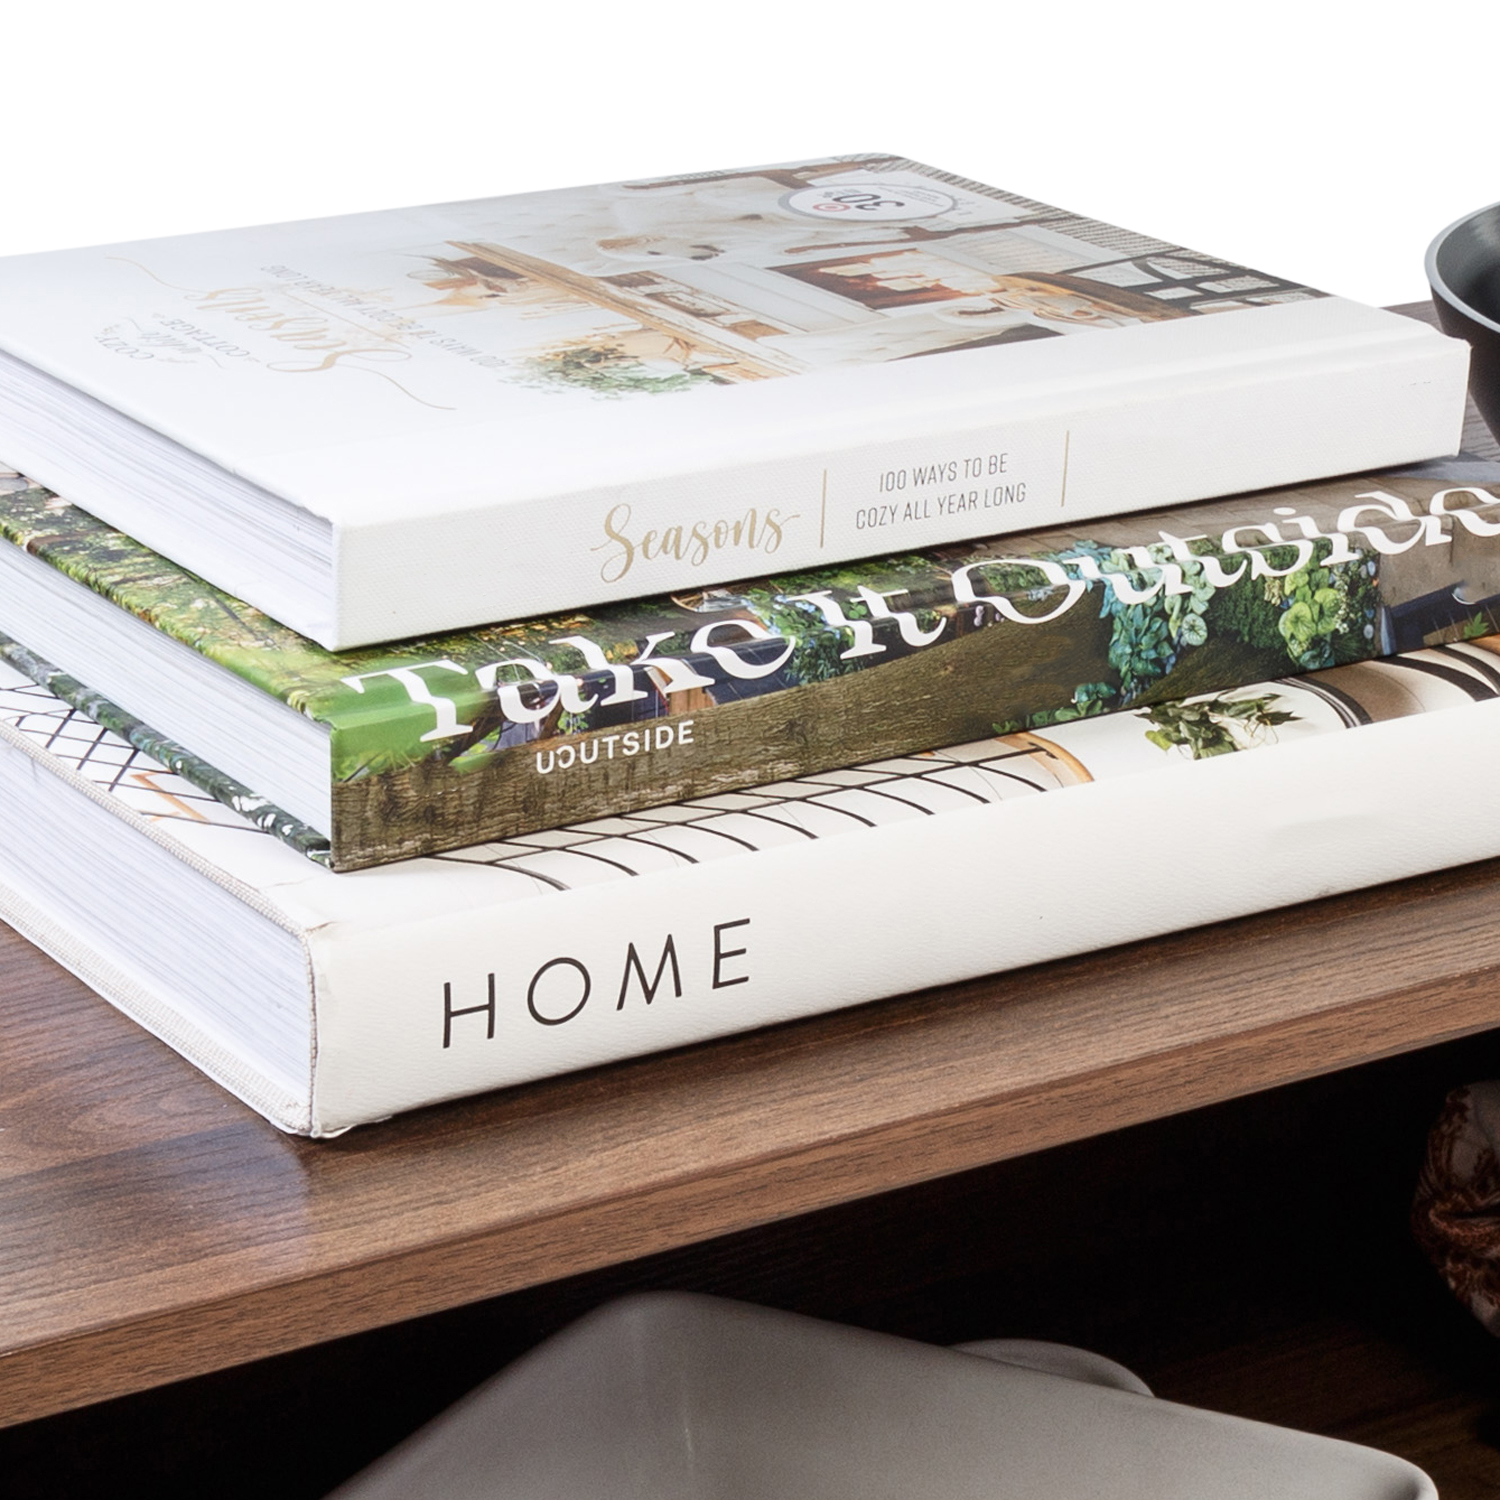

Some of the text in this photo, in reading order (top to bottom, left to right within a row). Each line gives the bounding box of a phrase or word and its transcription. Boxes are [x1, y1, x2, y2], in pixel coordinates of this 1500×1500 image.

[94, 336, 155, 360] COZY
[160, 318, 251, 357] COTTAGE
[879, 453, 1009, 493] 100 WAYS TO BE
[856, 482, 1027, 530] COZY ALL YEAR LONG
[590, 502, 801, 584] Seasons
[340, 618, 797, 743] Take
[787, 584, 948, 660] It
[443, 918, 750, 1049] HOME
